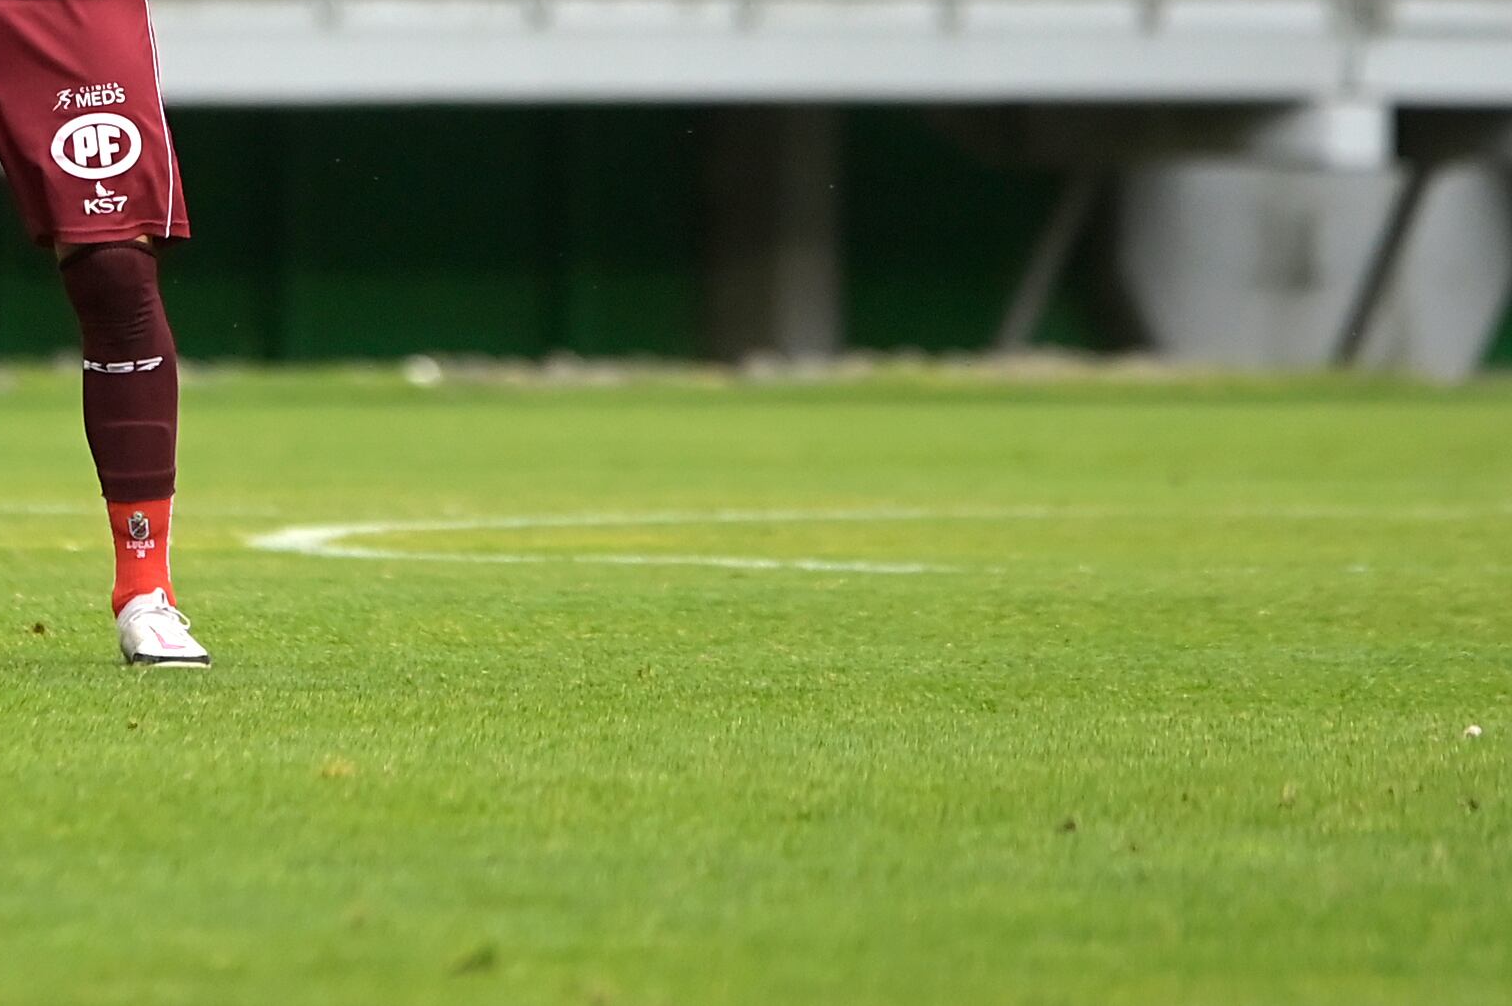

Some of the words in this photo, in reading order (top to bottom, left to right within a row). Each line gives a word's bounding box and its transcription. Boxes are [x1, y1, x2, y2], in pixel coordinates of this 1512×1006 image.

[75, 87, 127, 109] MEDS
[72, 123, 121, 168] PF
[83, 195, 128, 215] KS7
